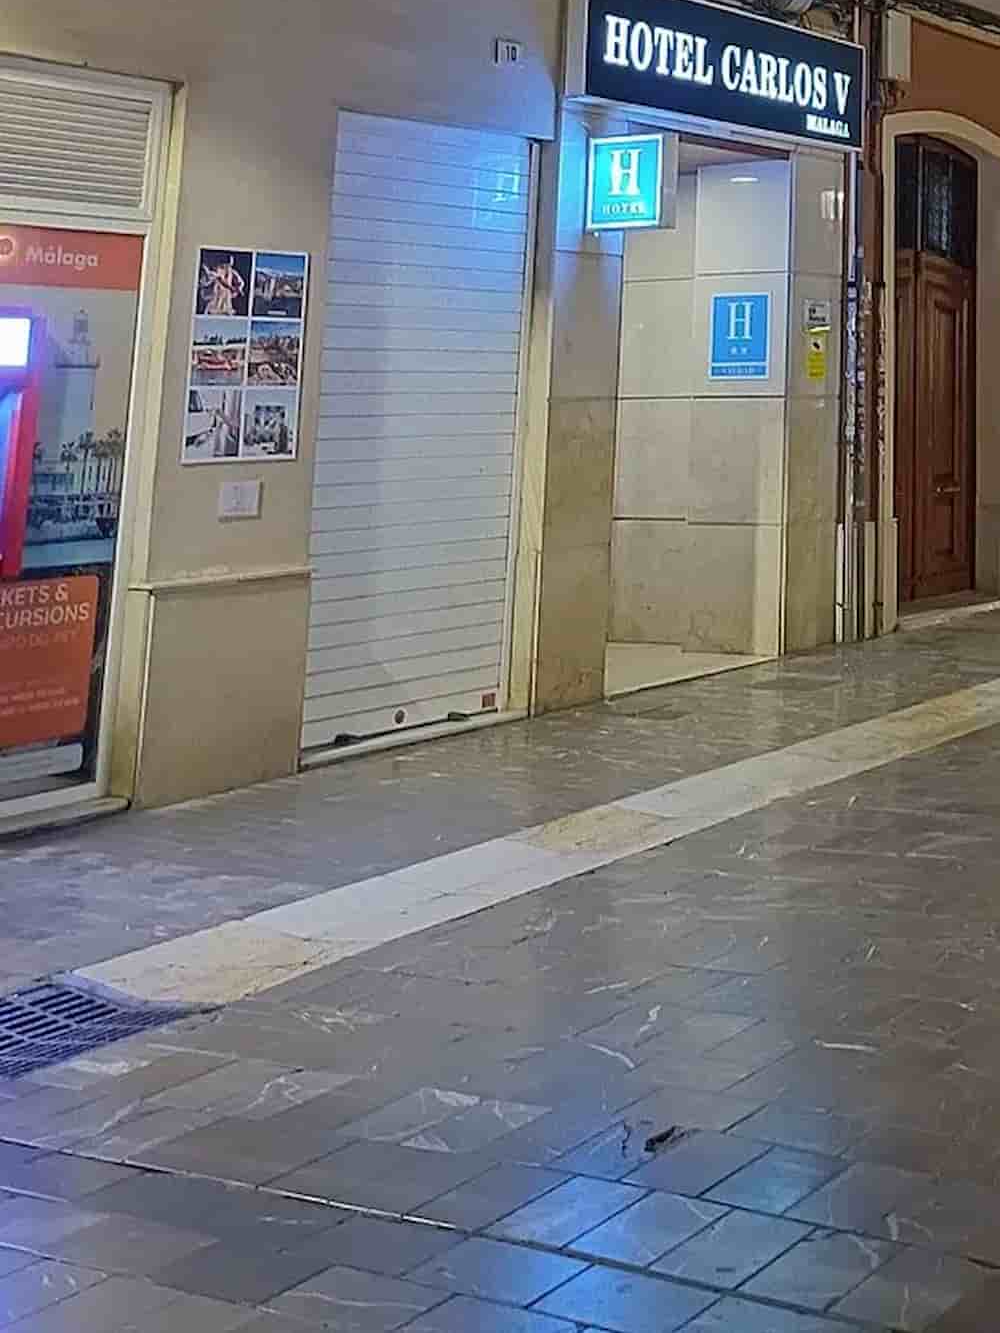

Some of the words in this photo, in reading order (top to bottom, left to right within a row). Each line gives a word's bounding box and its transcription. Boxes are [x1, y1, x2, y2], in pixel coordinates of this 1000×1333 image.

[603, 14, 713, 86] HOTEL
[721, 44, 827, 111] CARLOS
[833, 72, 851, 115] V
[608, 149, 642, 196] H
[727, 301, 753, 340] H
[54, 583, 69, 602] &
